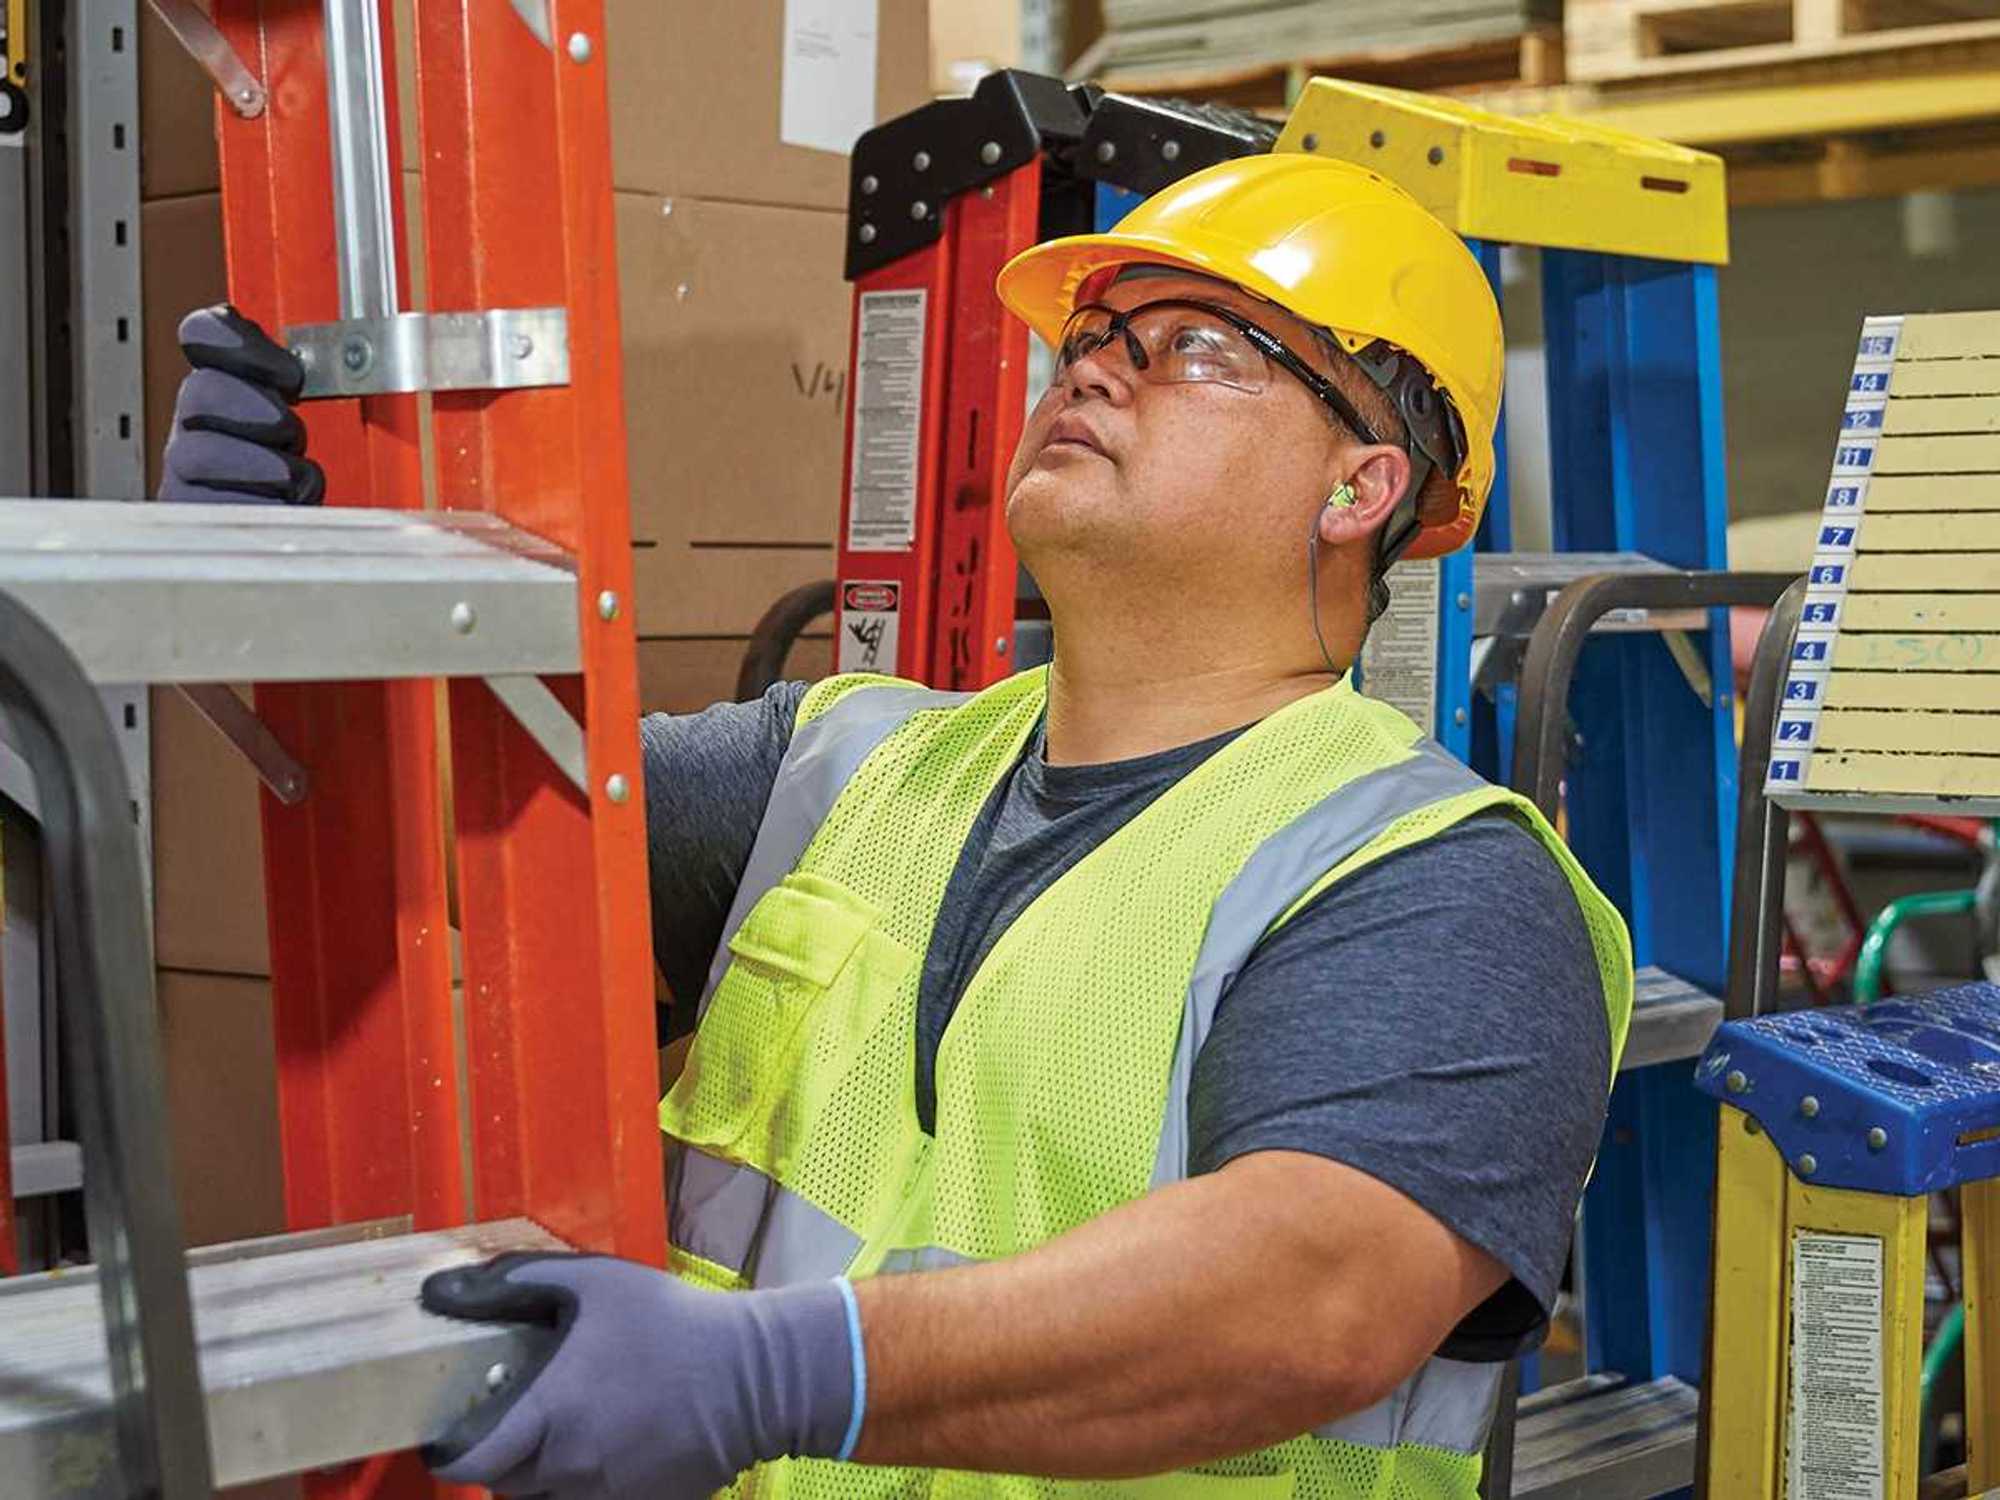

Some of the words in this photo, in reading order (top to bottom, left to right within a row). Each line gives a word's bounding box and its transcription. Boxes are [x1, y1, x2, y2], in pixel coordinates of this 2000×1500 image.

[1858, 374, 1877, 391] 14
[1850, 413, 1870, 427] 12
[1843, 449, 1861, 465] 11
[1836, 489, 1849, 505] 8
[1832, 529, 1844, 545] 7
[1820, 567, 1834, 583] 6
[1811, 604, 1825, 621] 5
[1801, 643, 1815, 660] 4
[1793, 683, 1808, 700] 3
[1786, 723, 1802, 741] 2
[1778, 764, 1789, 780] 1
